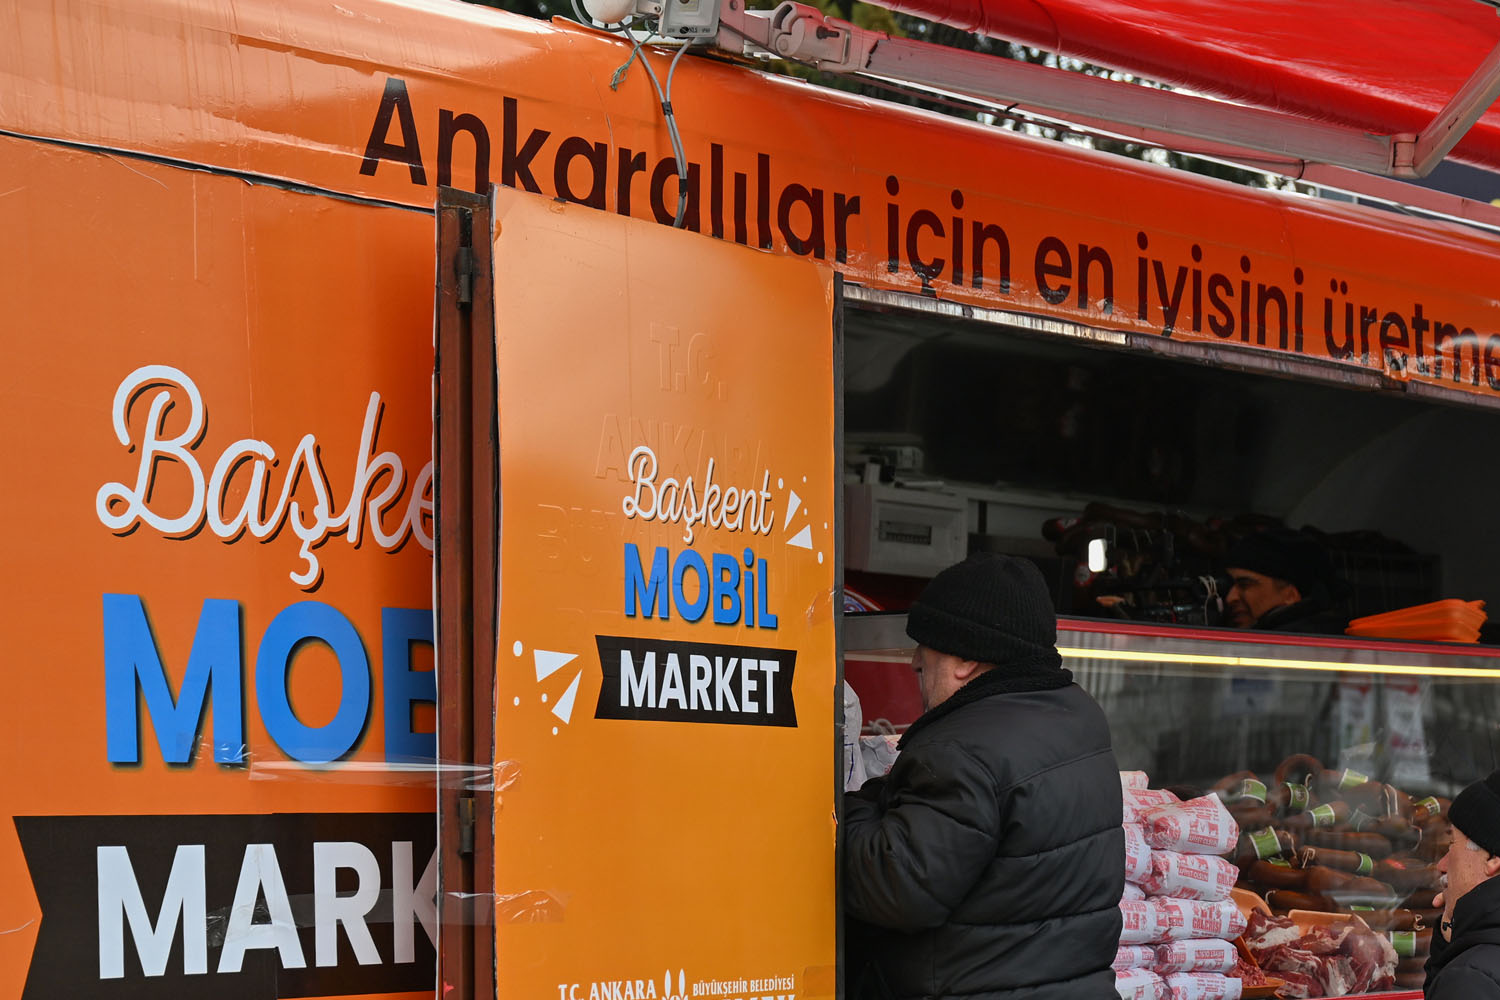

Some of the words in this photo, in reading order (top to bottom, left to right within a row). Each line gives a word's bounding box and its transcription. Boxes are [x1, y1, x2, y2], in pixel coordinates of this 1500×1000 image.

[359, 77, 861, 264] Ankaralılar
[886, 175, 1011, 297] için
[1034, 236, 1114, 315] en
[1136, 231, 1306, 353] iyisini
[622, 446, 775, 545] Başkent
[620, 649, 780, 714] MARKET
[692, 977, 748, 998] BÜYÜKŞEHİR
[750, 973, 795, 993] BELEDİYESİ
